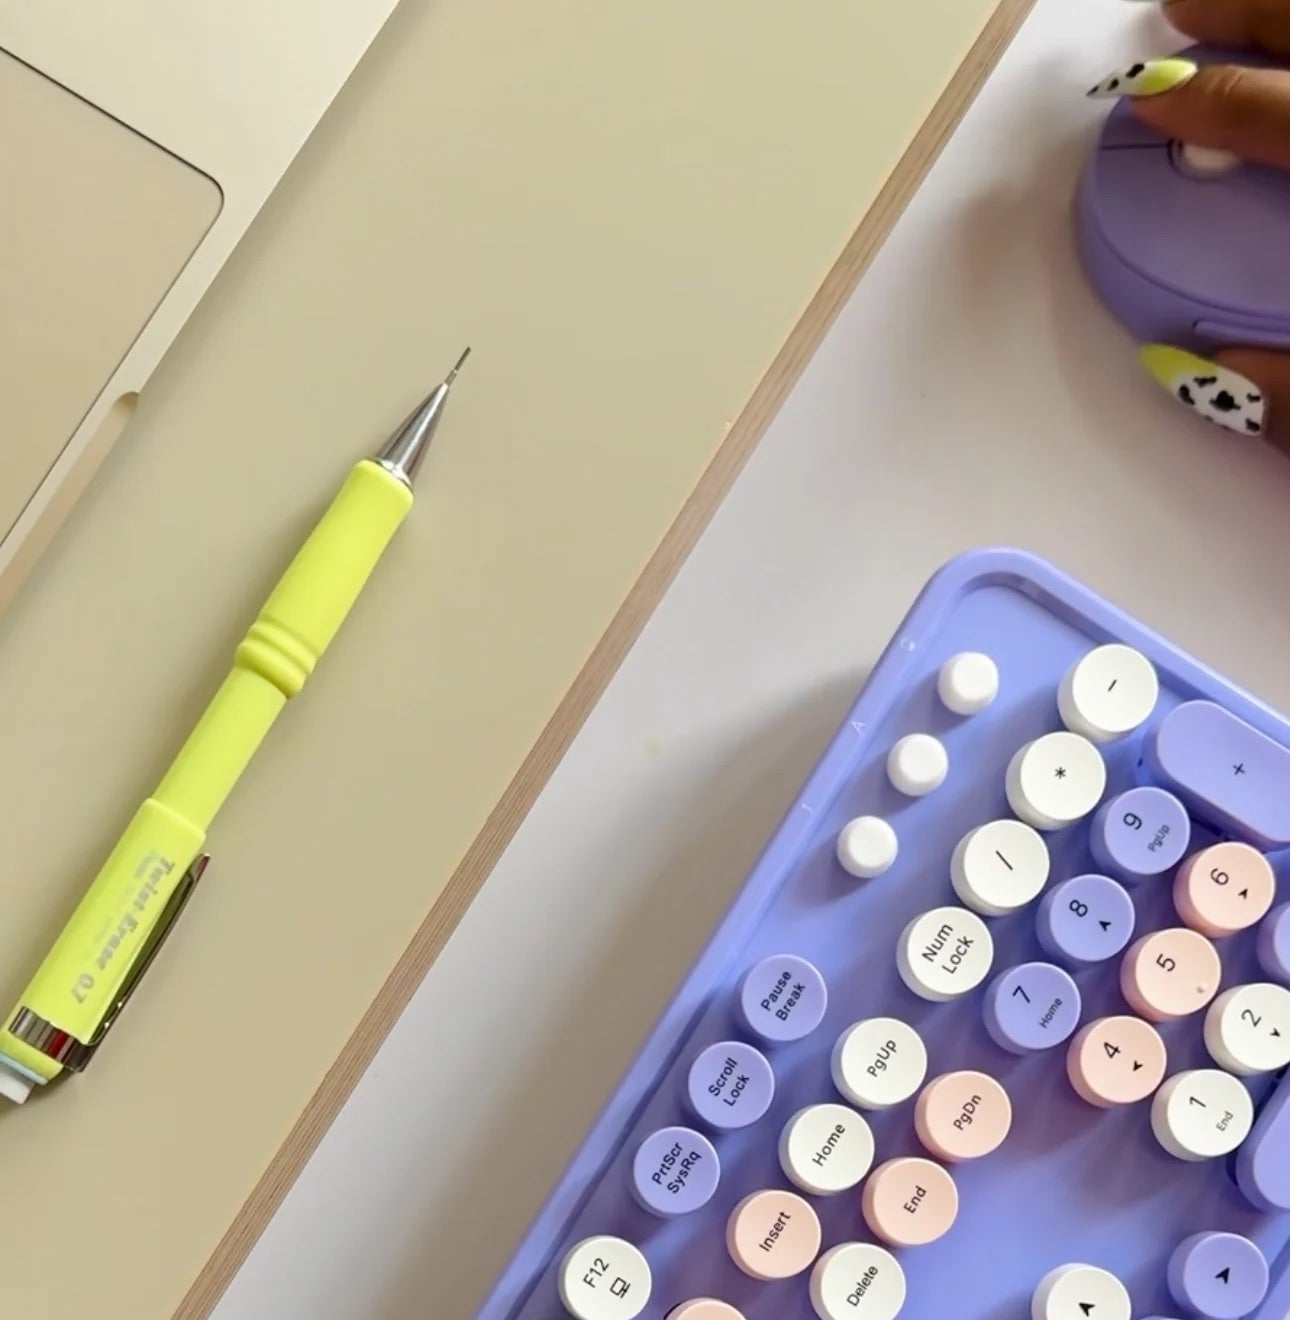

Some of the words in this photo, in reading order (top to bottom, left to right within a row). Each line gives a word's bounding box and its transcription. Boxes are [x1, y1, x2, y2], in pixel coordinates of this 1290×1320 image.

[1122, 812, 1143, 831] 9
[1147, 824, 1170, 852] PgUp
[1210, 867, 1230, 886] 6
[1068, 899, 1089, 918] 8
[922, 923, 954, 962] Num
[942, 935, 975, 975] Lock
[1155, 953, 1176, 972] 5
[760, 970, 792, 1013] Pause
[775, 981, 806, 1022] Break
[1012, 985, 1031, 1004] 7
[1038, 997, 1063, 1029] Home
[1241, 1009, 1262, 1027] 2
[866, 1039, 897, 1077] PgUp
[1103, 1041, 1121, 1059] 4
[708, 1057, 737, 1098] Scroll
[722, 1072, 750, 1107] Lock
[953, 1094, 982, 1131] PgDn
[1189, 1096, 1206, 1108] 1
[1215, 1110, 1234, 1132] End
[811, 1124, 846, 1167] Home
[651, 1141, 683, 1186] PrtScr
[667, 1151, 703, 1194] SysRq
[903, 1185, 927, 1214] End
[759, 1211, 791, 1252] Insert
[582, 1257, 610, 1289] F12
[846, 1266, 879, 1307] Delete
